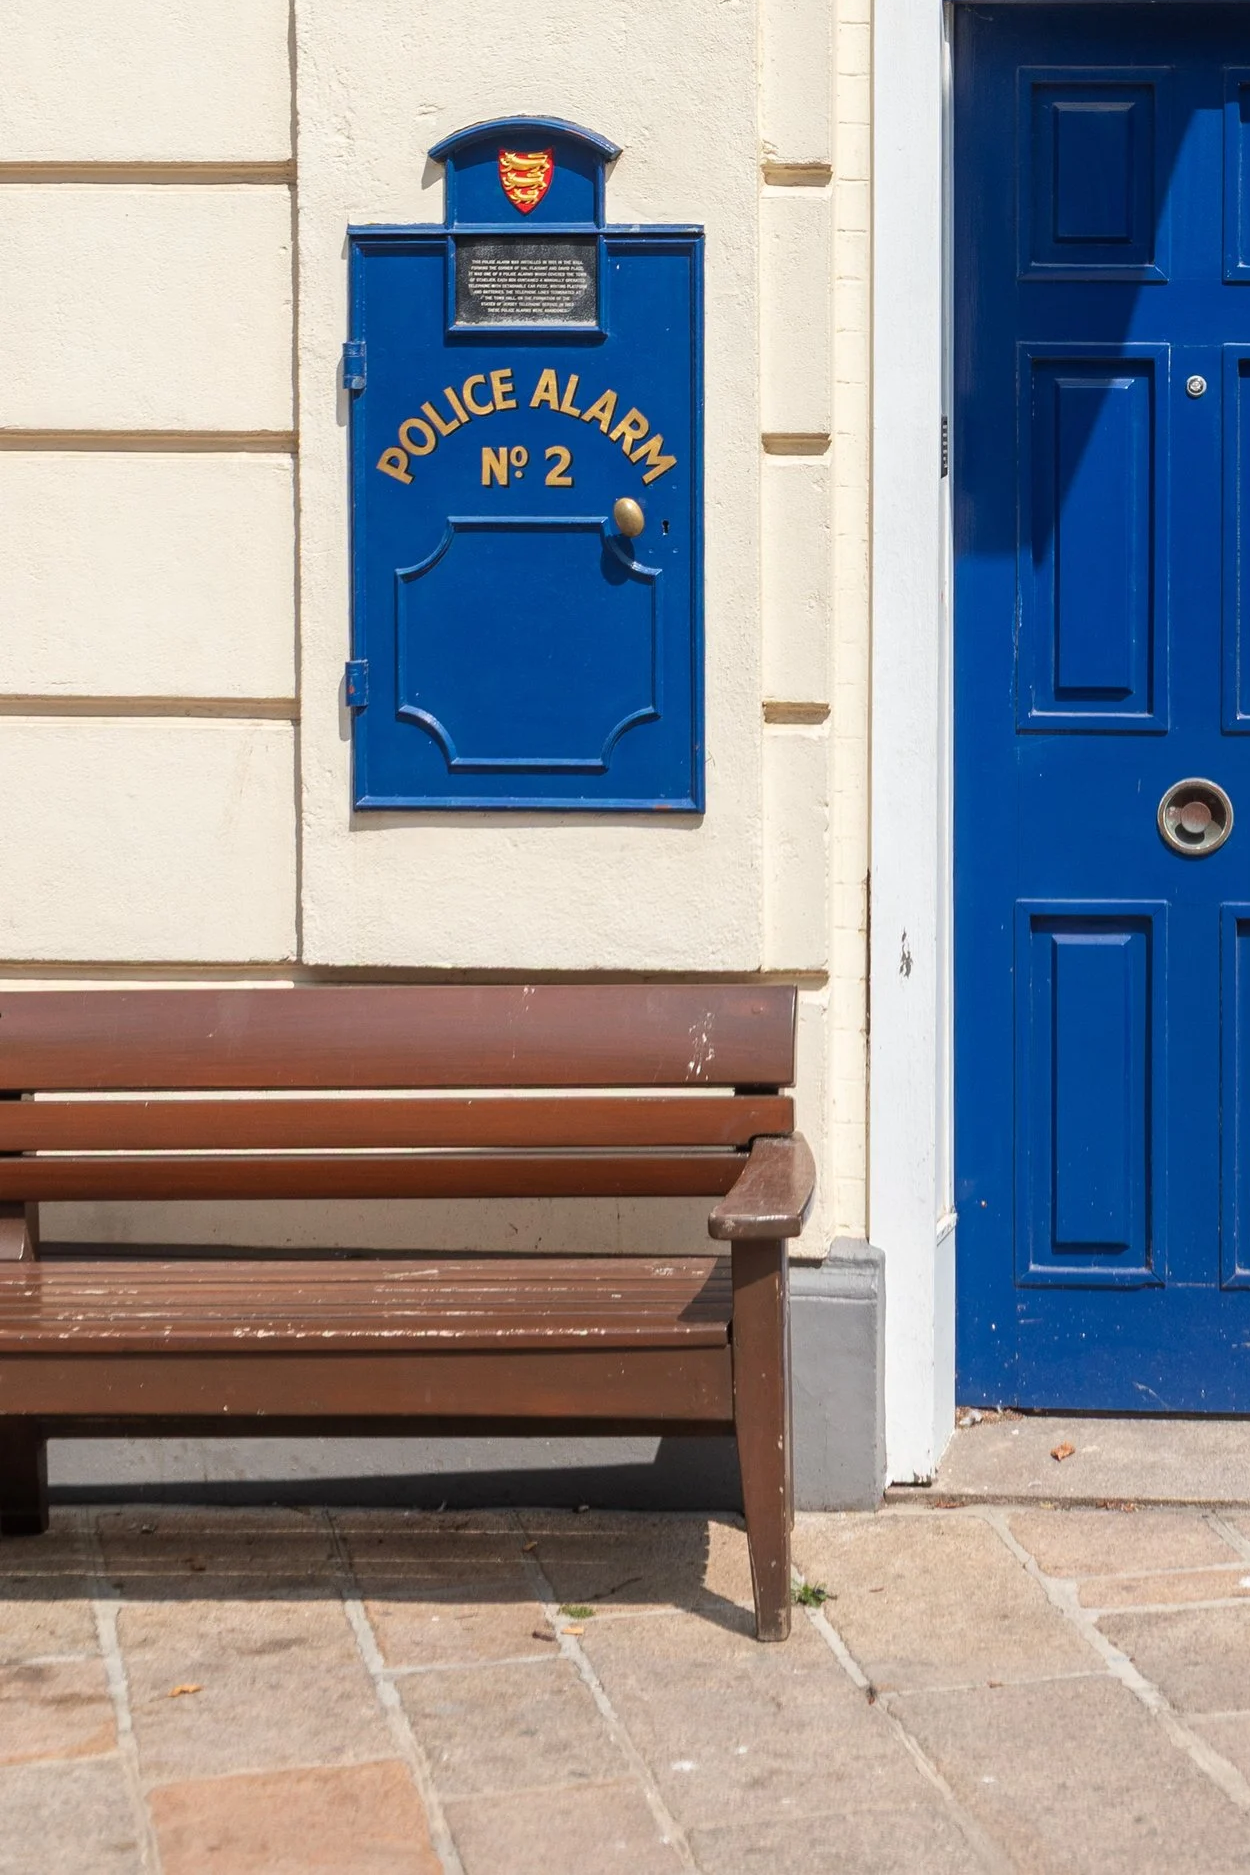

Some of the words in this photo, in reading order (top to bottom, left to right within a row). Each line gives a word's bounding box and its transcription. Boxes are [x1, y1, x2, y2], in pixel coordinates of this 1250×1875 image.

[376, 368, 517, 485] POLICE
[529, 368, 677, 485] ALARM
[545, 445, 573, 486] 2
